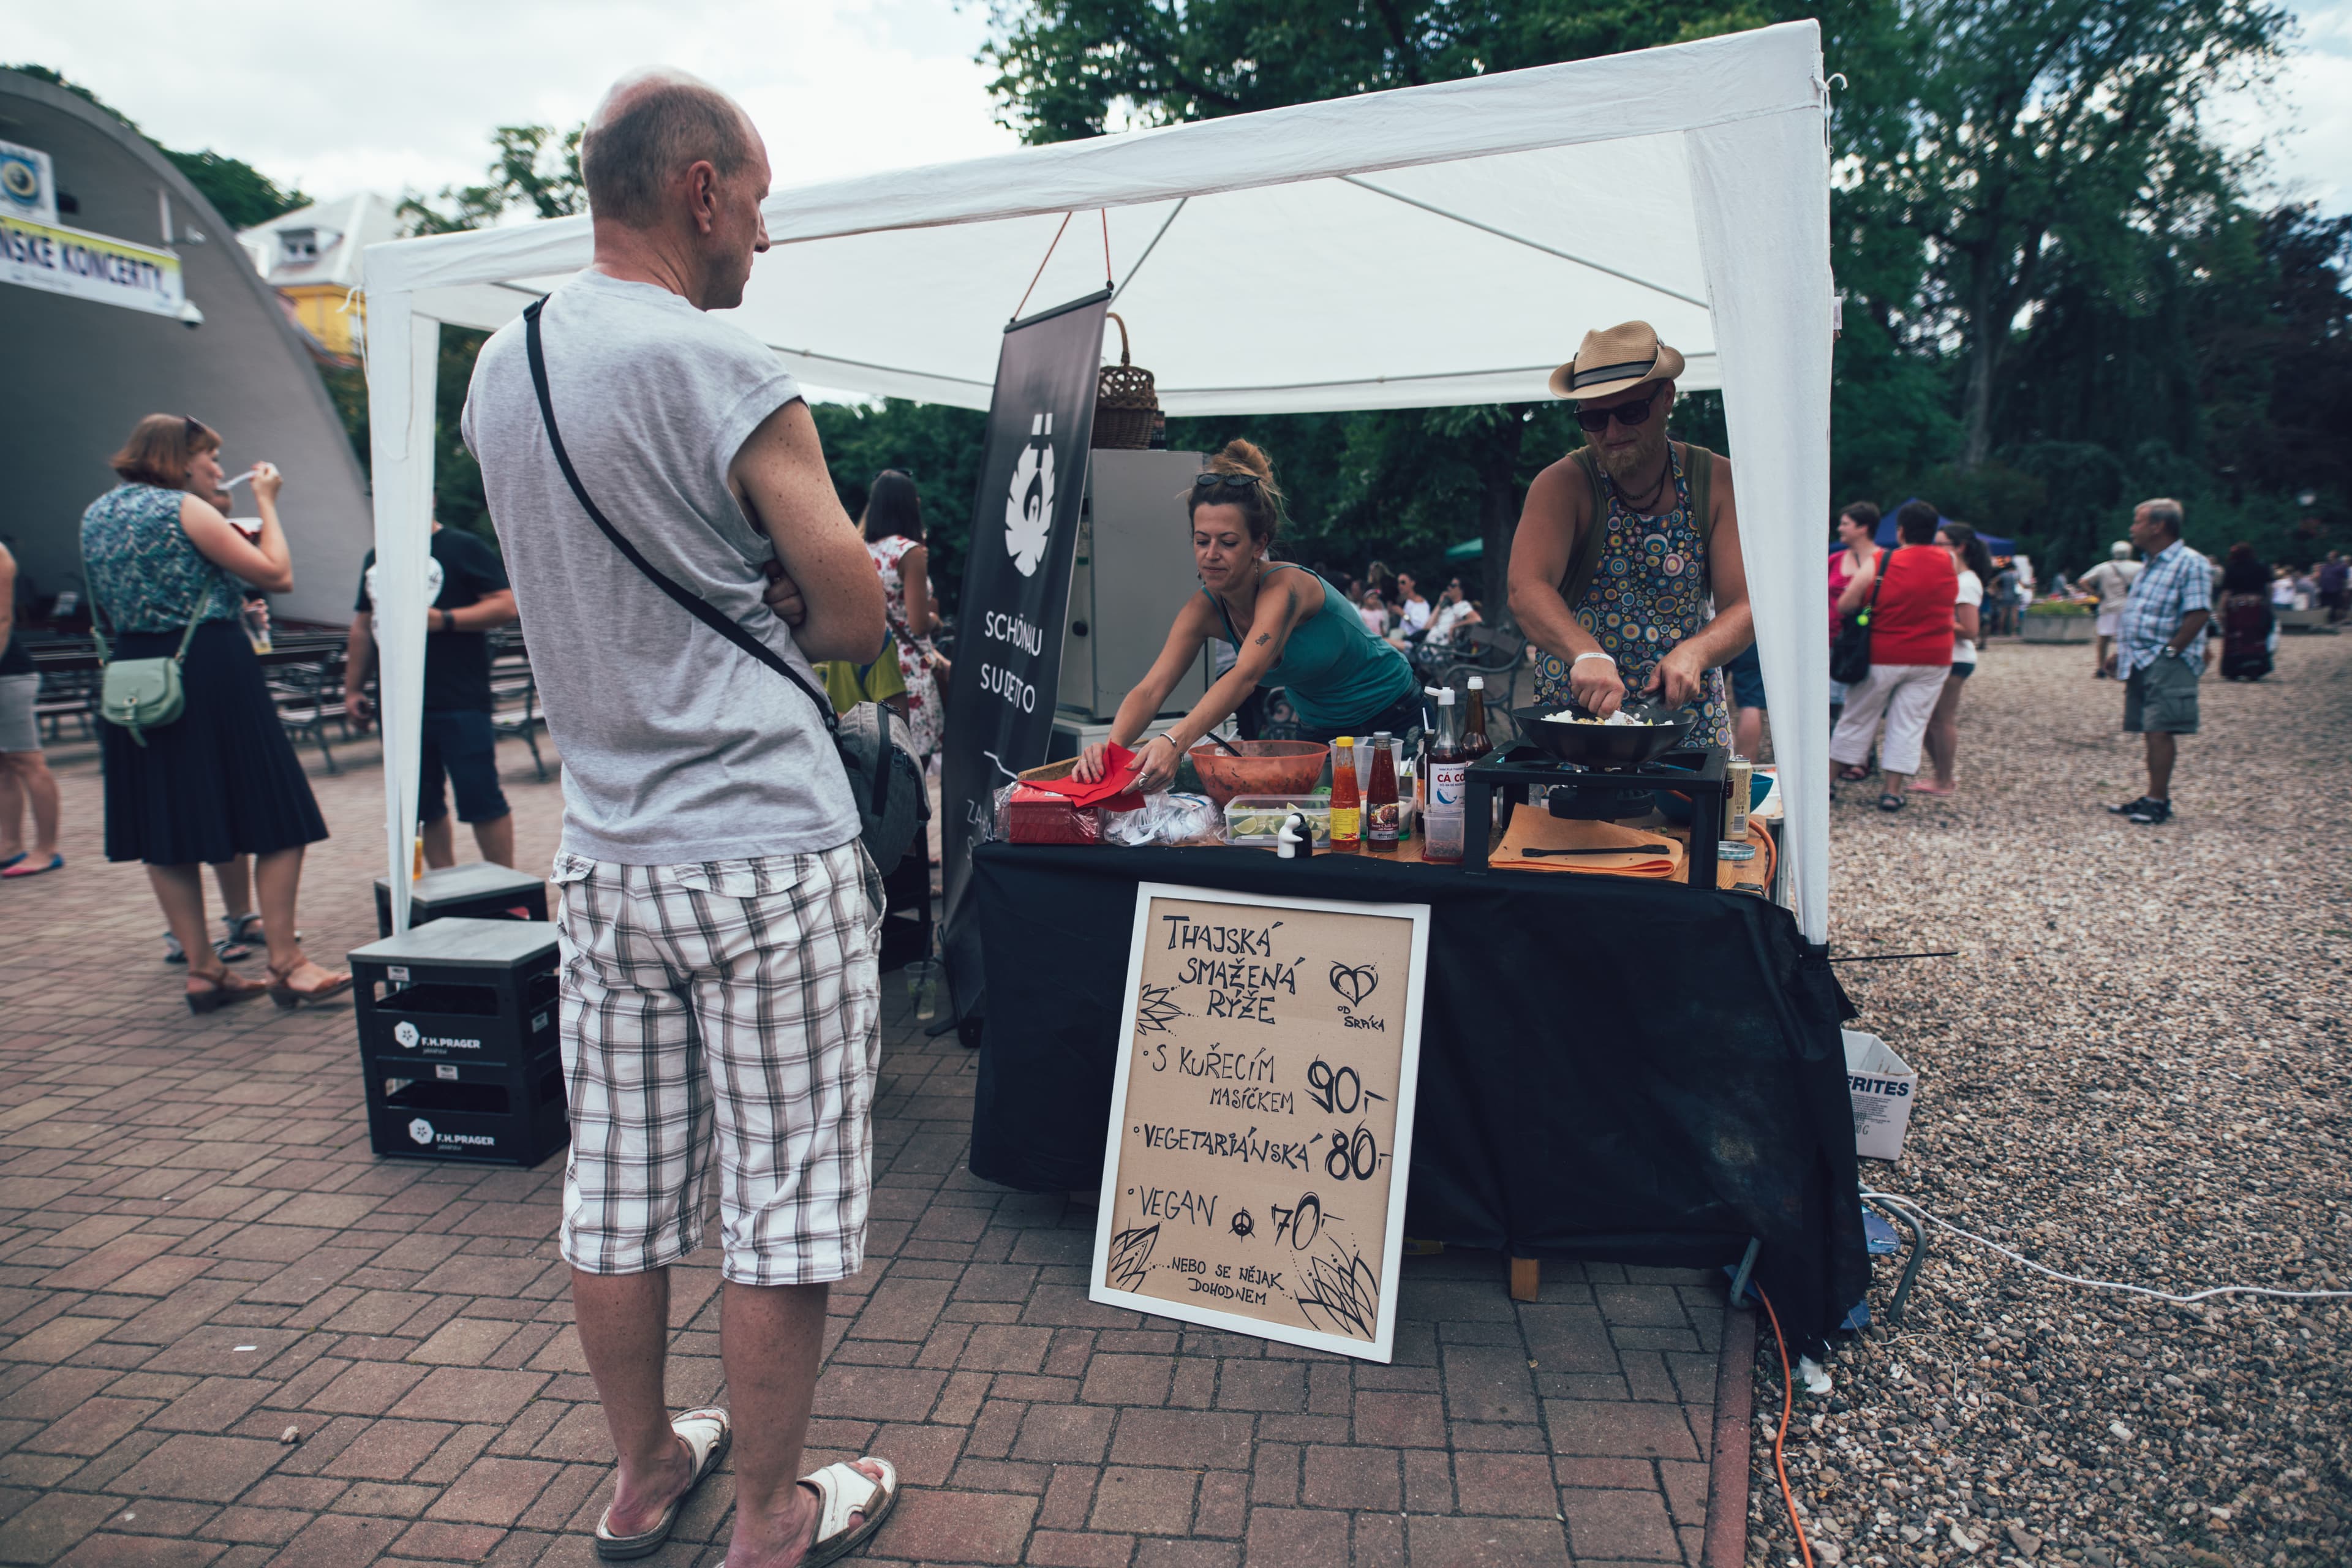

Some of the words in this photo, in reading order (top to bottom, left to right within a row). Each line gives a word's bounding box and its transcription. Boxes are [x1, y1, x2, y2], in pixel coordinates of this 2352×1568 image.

[1437, 772, 1451, 783] CÁ
[1163, 915, 1284, 957] THAJSKÁ
[1178, 957, 1306, 995] SMAŽENÁ
[1207, 989, 1276, 1025] RÝŽE
[1152, 1044, 1167, 1072] S
[1178, 1042, 1275, 1084] KUŘECÍM
[1209, 1087, 1294, 1115] MASÍČKEM
[1139, 1185, 1219, 1227] VEGAN
[1171, 1256, 1207, 1275] NEBO
[1215, 1264, 1232, 1279] SE
[1238, 1265, 1285, 1291] NĚJAK
[1187, 1277, 1267, 1305] DOHODNEM
